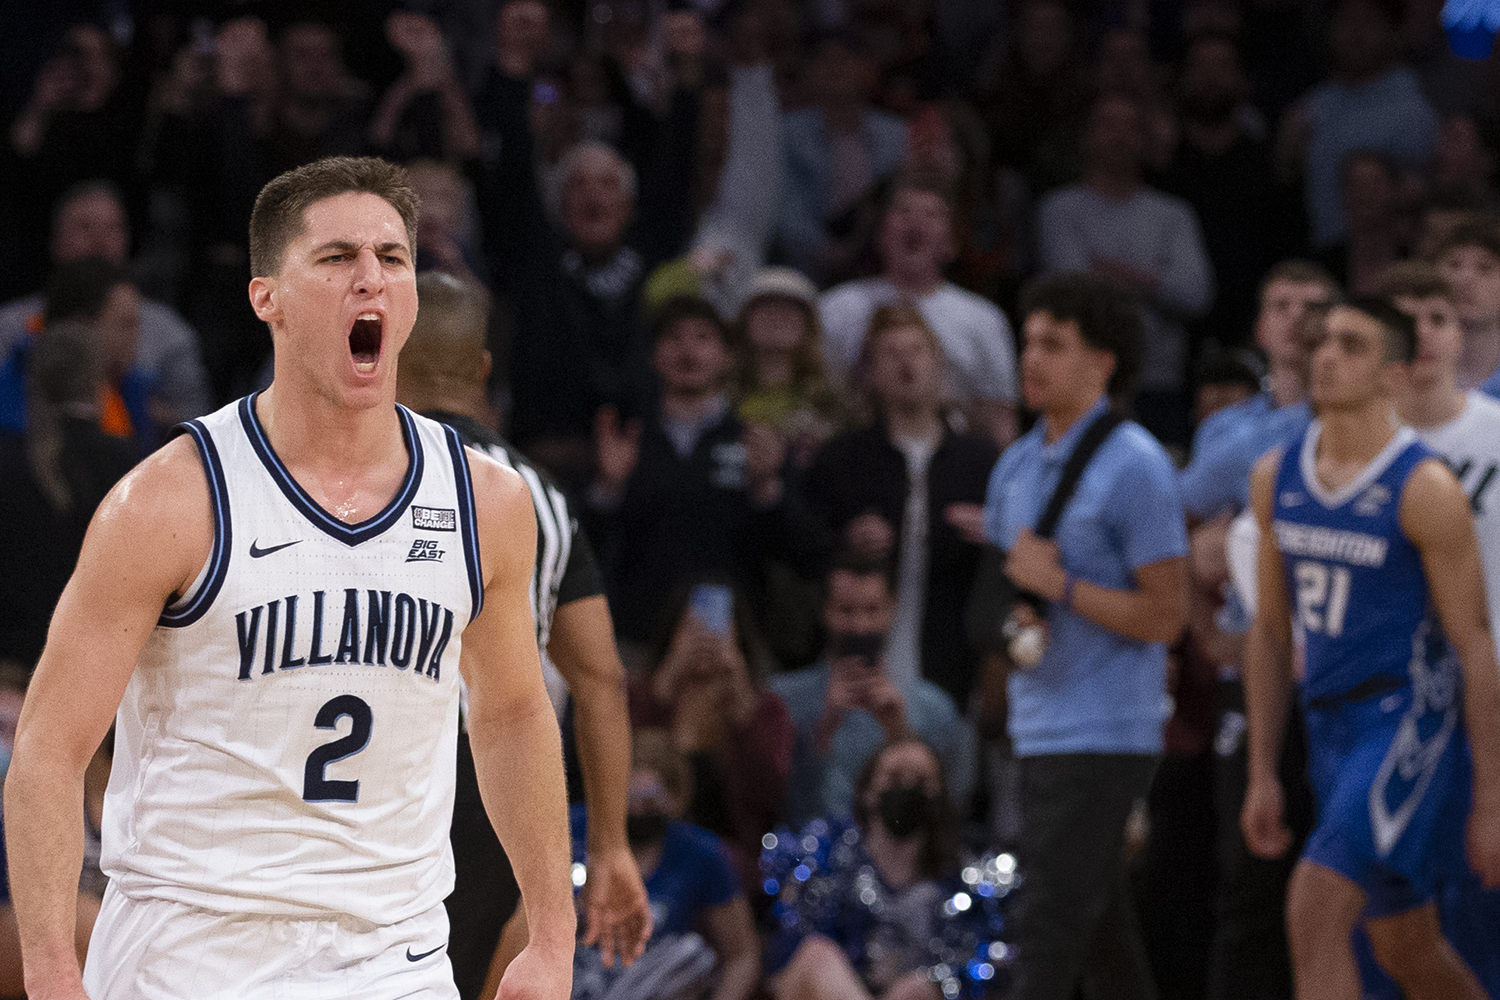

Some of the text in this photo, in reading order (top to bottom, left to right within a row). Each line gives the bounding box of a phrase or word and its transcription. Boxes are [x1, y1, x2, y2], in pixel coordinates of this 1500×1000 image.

[412, 539, 439, 549] BIG
[414, 518, 455, 529] CHANGE
[408, 549, 446, 559] EAST
[1293, 560, 1351, 638] 21
[235, 588, 454, 683] VILLANOVA
[303, 694, 373, 803] 2
